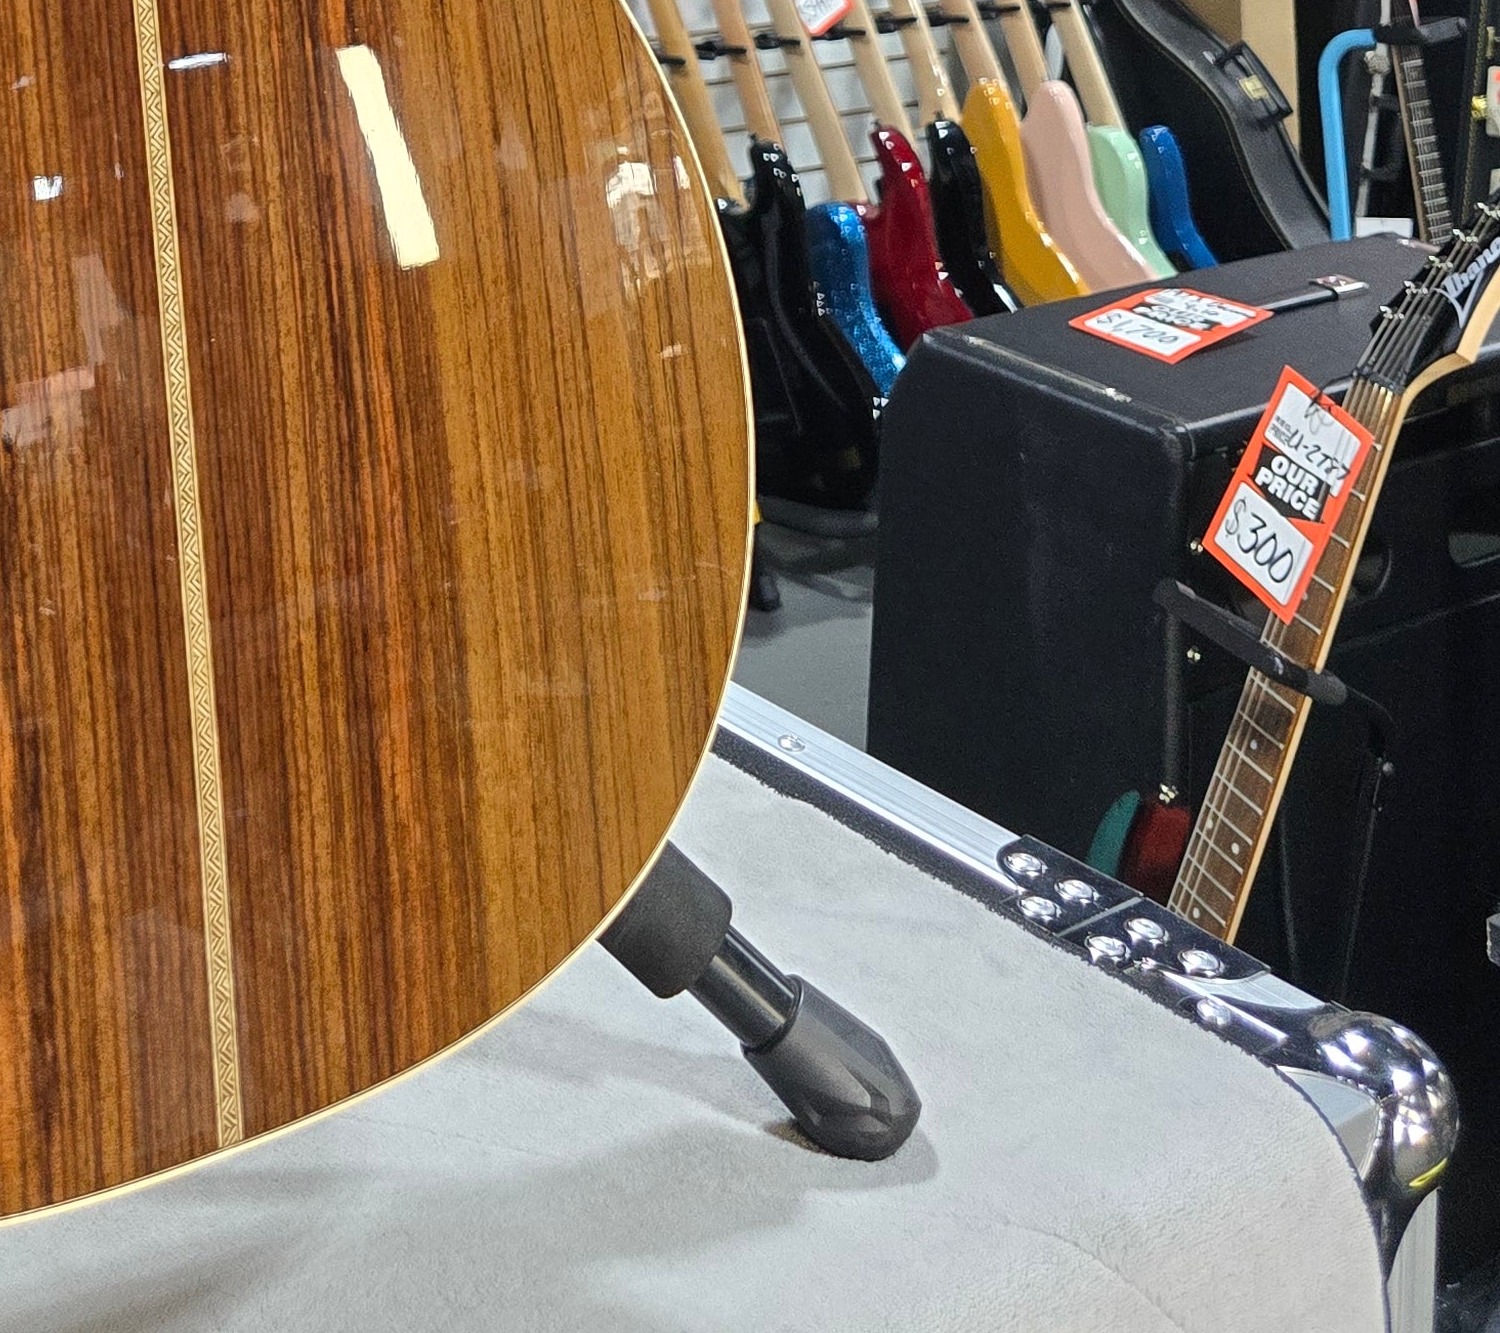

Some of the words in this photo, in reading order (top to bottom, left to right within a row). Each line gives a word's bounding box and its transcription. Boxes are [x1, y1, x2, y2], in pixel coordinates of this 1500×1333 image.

[1096, 312, 1179, 345] $1,700
[1254, 466, 1322, 521] PRICE
[1271, 455, 1320, 495] OUR
[1224, 495, 1295, 584] $300
